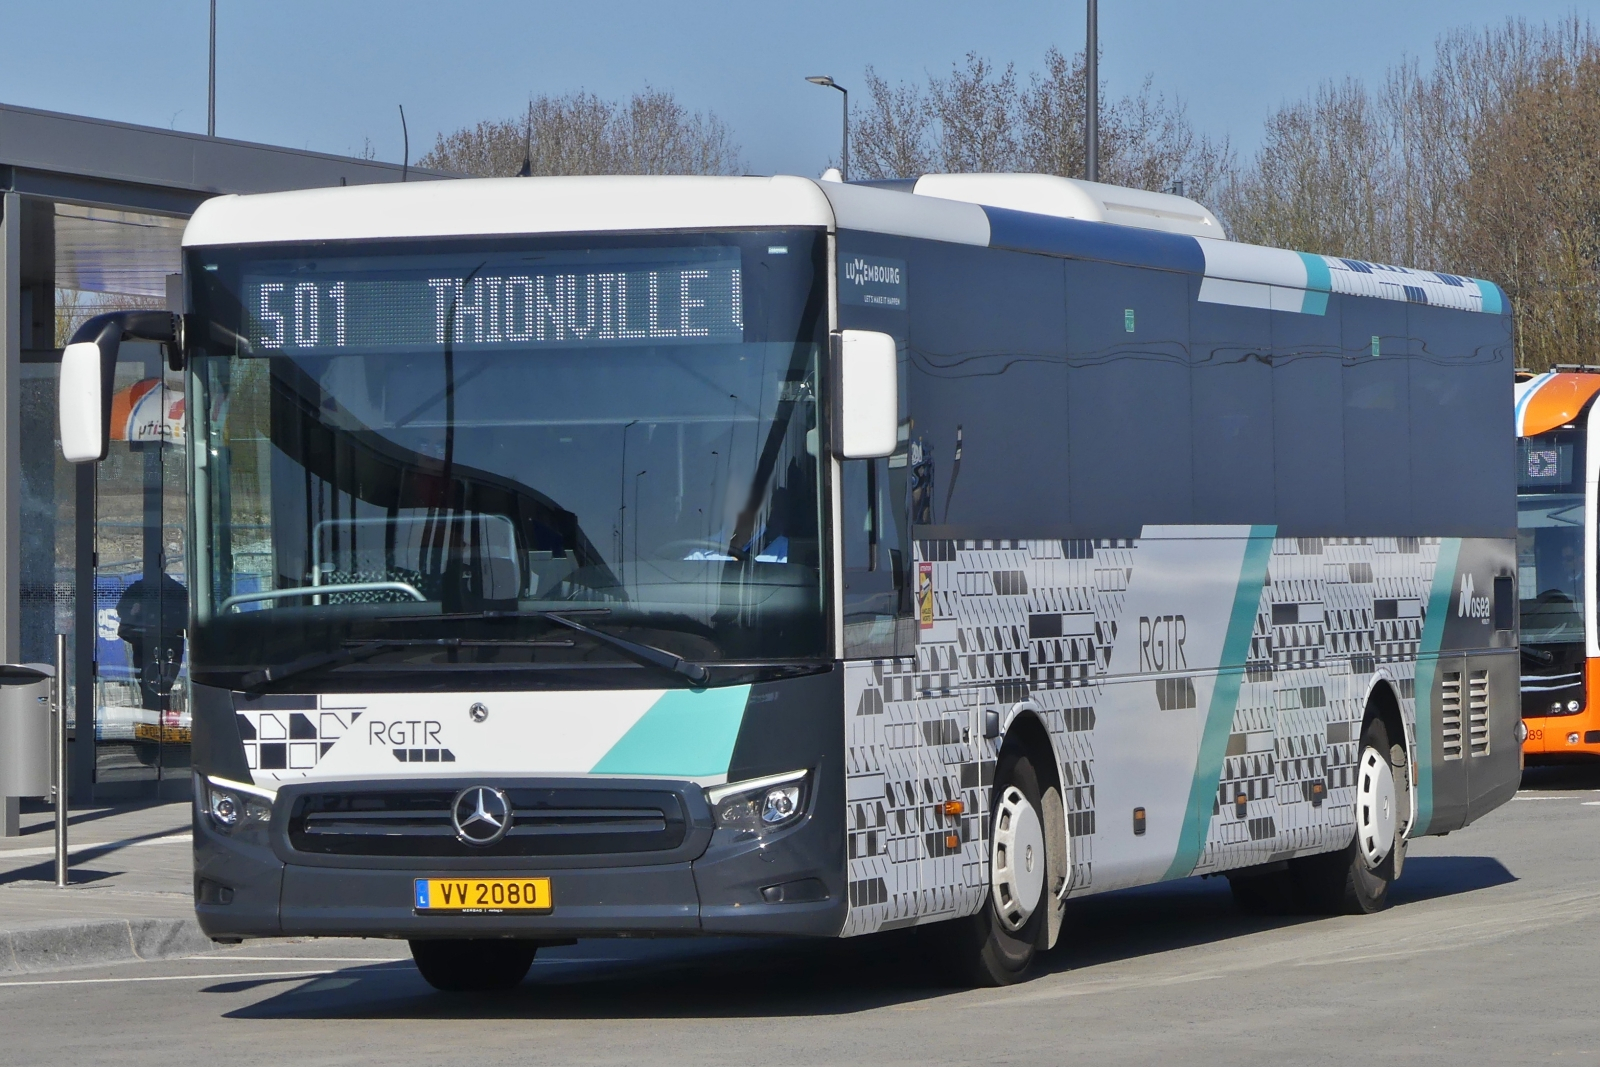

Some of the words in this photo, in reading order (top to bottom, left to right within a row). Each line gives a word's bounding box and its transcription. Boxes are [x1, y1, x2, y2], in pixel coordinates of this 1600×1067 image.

[845, 258, 900, 286] LUXEMBOURG
[260, 281, 345, 349] 501
[428, 269, 709, 345] THIONVILLE
[1139, 614, 1187, 673] RGTR
[369, 720, 442, 745] RGTR
[420, 895, 426, 904] L
[440, 883, 468, 905] VV
[475, 882, 537, 905] 2080
